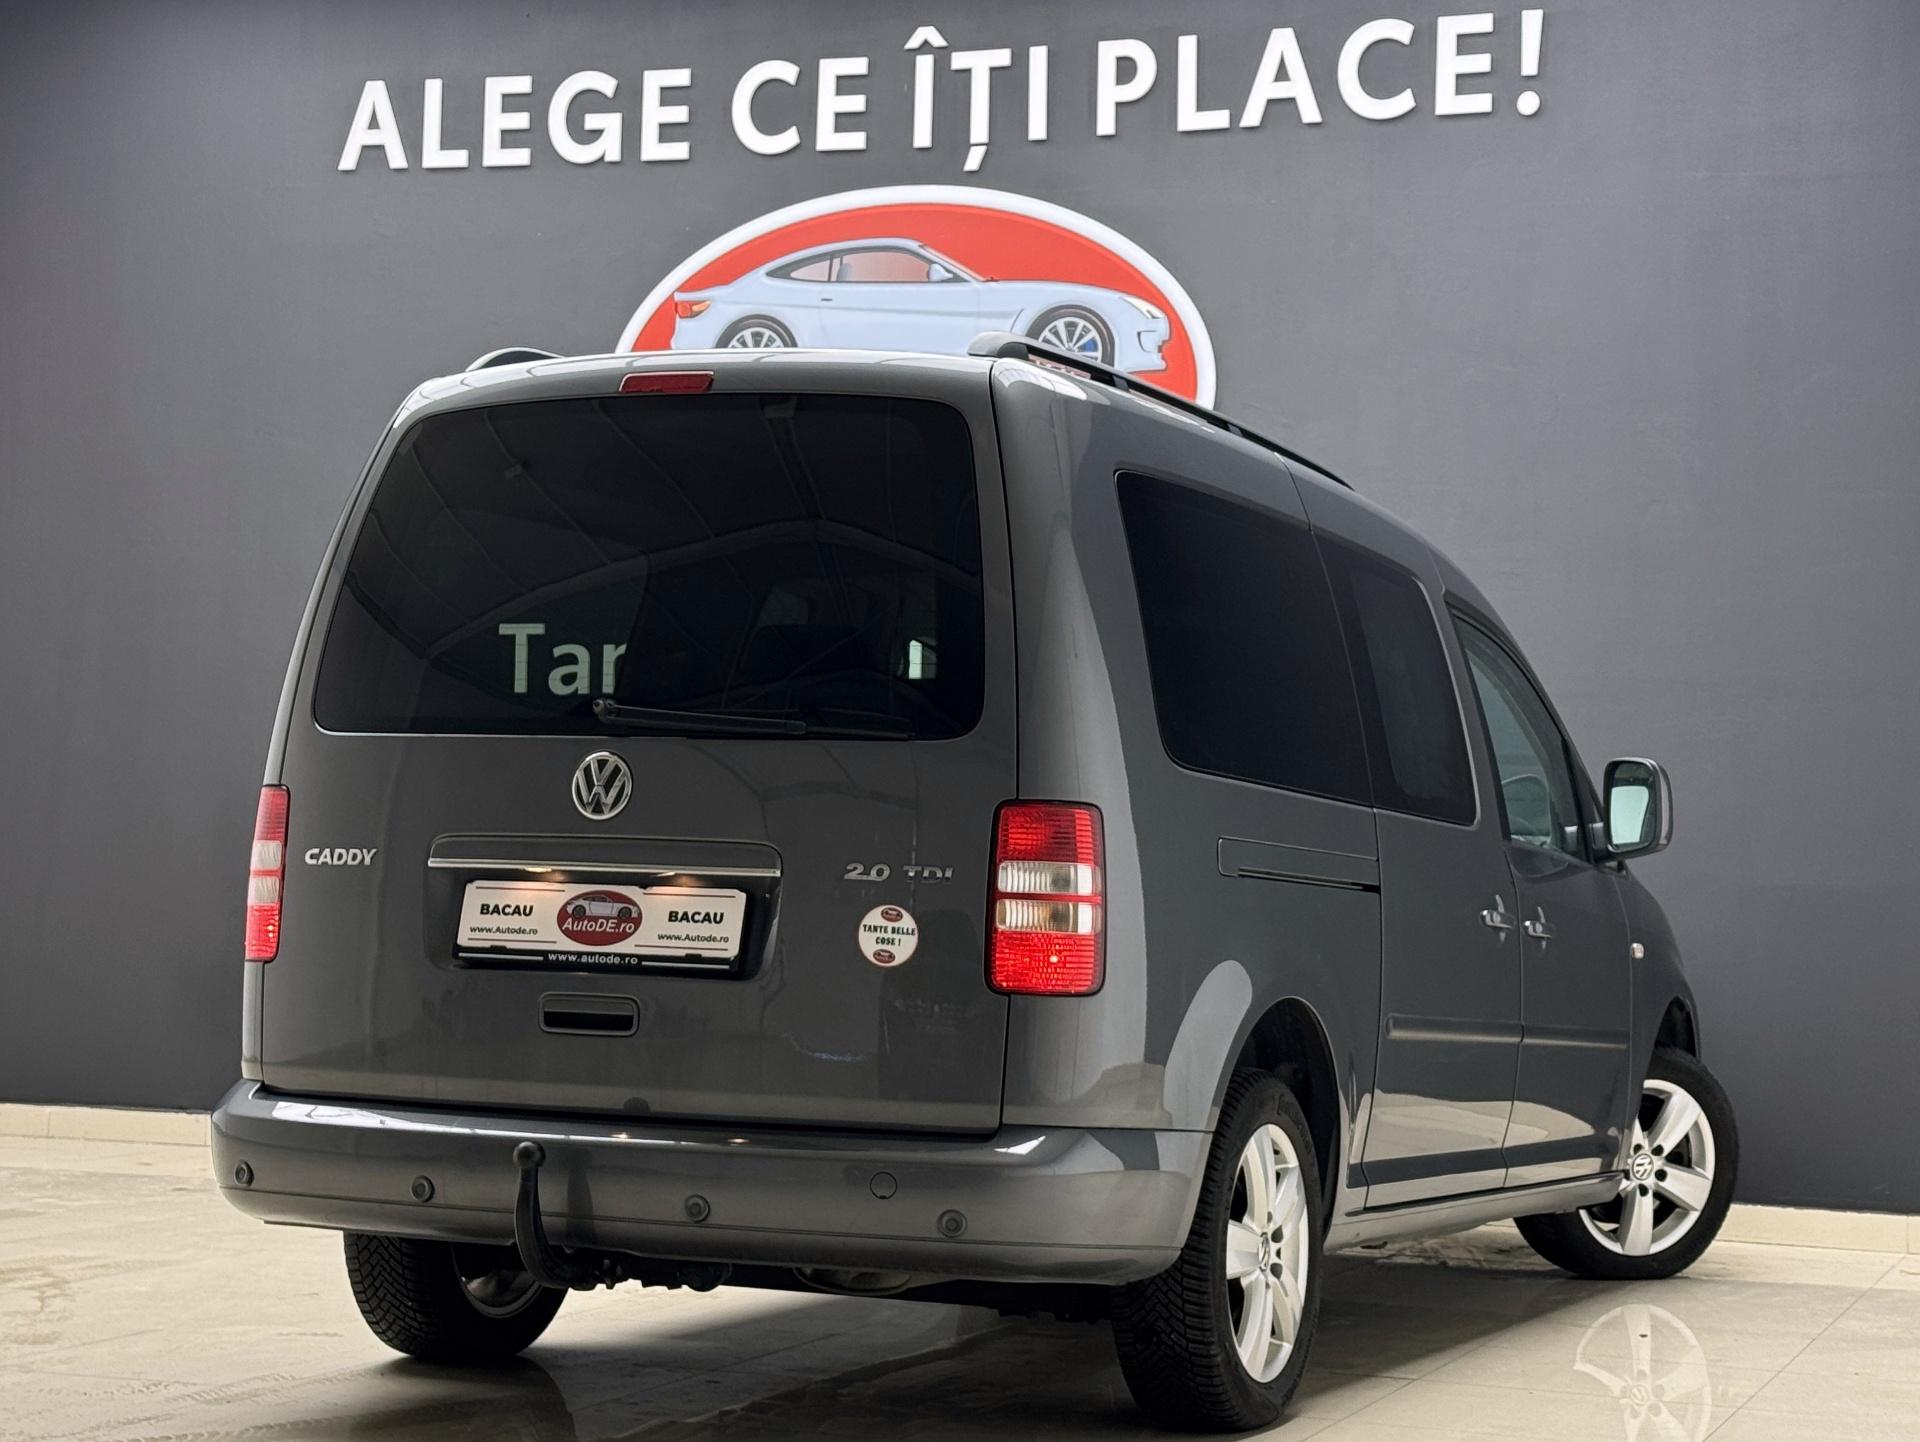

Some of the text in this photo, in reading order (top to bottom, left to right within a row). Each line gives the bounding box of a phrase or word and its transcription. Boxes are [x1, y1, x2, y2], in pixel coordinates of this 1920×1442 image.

[337, 8, 1544, 173] ALEGE CE ÎȚI PLACE!
[304, 848, 377, 866] CADDY
[903, 865, 953, 883] TDI
[479, 903, 534, 918] BACAU
[667, 910, 725, 925] BACAU
[469, 925, 538, 936] www.Autode.ro
[562, 916, 636, 934] AutoDE.ro
[863, 924, 916, 936] TANTE BELLE
[657, 931, 730, 944] www.Autode.ro
[875, 936, 896, 946] COSE
[548, 952, 639, 966] www.autode.ro
